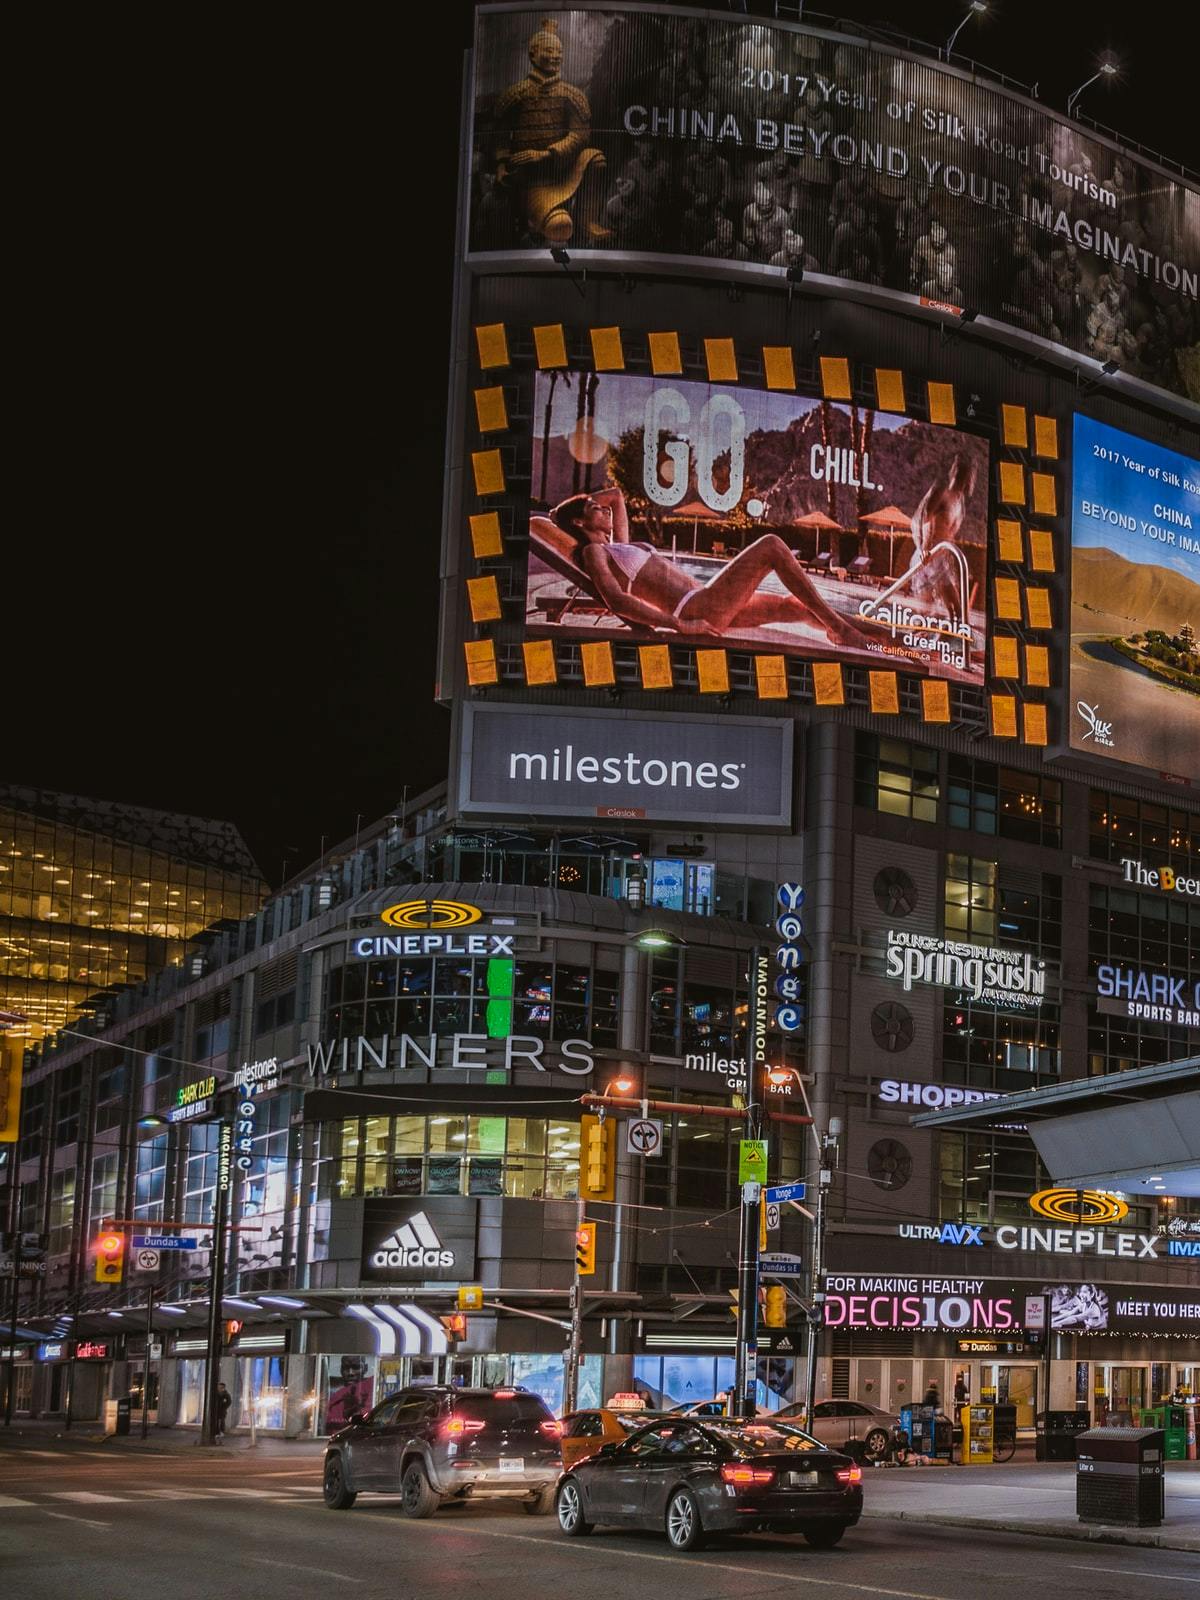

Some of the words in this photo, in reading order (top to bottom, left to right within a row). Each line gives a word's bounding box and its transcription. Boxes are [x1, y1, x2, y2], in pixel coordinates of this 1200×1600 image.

[741, 67, 808, 97] 2017
[816, 79, 878, 112] Year
[886, 101, 916, 124] of
[922, 108, 967, 143] Silk
[975, 126, 1029, 167] Road
[1036, 151, 1117, 209] Tourism
[623, 104, 743, 146] CHINA
[755, 118, 910, 178] BEYOND
[921, 155, 1011, 211] YOUR
[1022, 192, 1199, 300] IMAGINATION
[643, 387, 764, 518] GO.
[810, 443, 884, 491] CHILL.
[1093, 444, 1120, 464] 2017
[1122, 455, 1145, 473] Year
[1148, 467, 1160, 480] of
[1162, 471, 1180, 488] Silk
[1082, 500, 1137, 532] BEYOND
[1140, 520, 1176, 546] YOUR
[1154, 503, 1193, 529] CHINA
[859, 600, 972, 639] California
[866, 642, 931, 662] visitcalifornia.ca
[903, 632, 950, 653] dream
[941, 651, 966, 669] big
[509, 745, 741, 790] milestones
[1120, 858, 1159, 888] The
[357, 935, 513, 957] CINEPLEX
[888, 930, 938, 950] LOUNGE
[945, 941, 1023, 966] RESTAURANT
[1097, 965, 1186, 1009] SHARK
[756, 956, 769, 1061] DOWNTOWN
[1128, 1002, 1173, 1022] SPORTS
[1177, 1010, 1200, 1026] BAR
[307, 1033, 594, 1077] WINNERS
[233, 1057, 277, 1087] milestones
[178, 1084, 198, 1106] SHARK
[198, 1076, 215, 1099] CLUB
[770, 1084, 792, 1095] BAR
[220, 1126, 231, 1191] DOWNTOWN
[775, 1188, 791, 1200] Yonge
[144, 1237, 179, 1247] Dundas
[899, 1224, 940, 1240] ULTRA
[938, 1223, 984, 1246] AVX
[996, 1225, 1159, 1259] CINEPLEX
[373, 1246, 455, 1267] adidas
[762, 1262, 786, 1272] Dundas
[825, 1277, 856, 1292] FOR
[860, 1279, 918, 1293] MAKING
[922, 1280, 984, 1295] HEALTHY
[1116, 1302, 1150, 1318] MEET
[1153, 1303, 1176, 1318] YOU
[971, 1343, 998, 1352] Dundas
